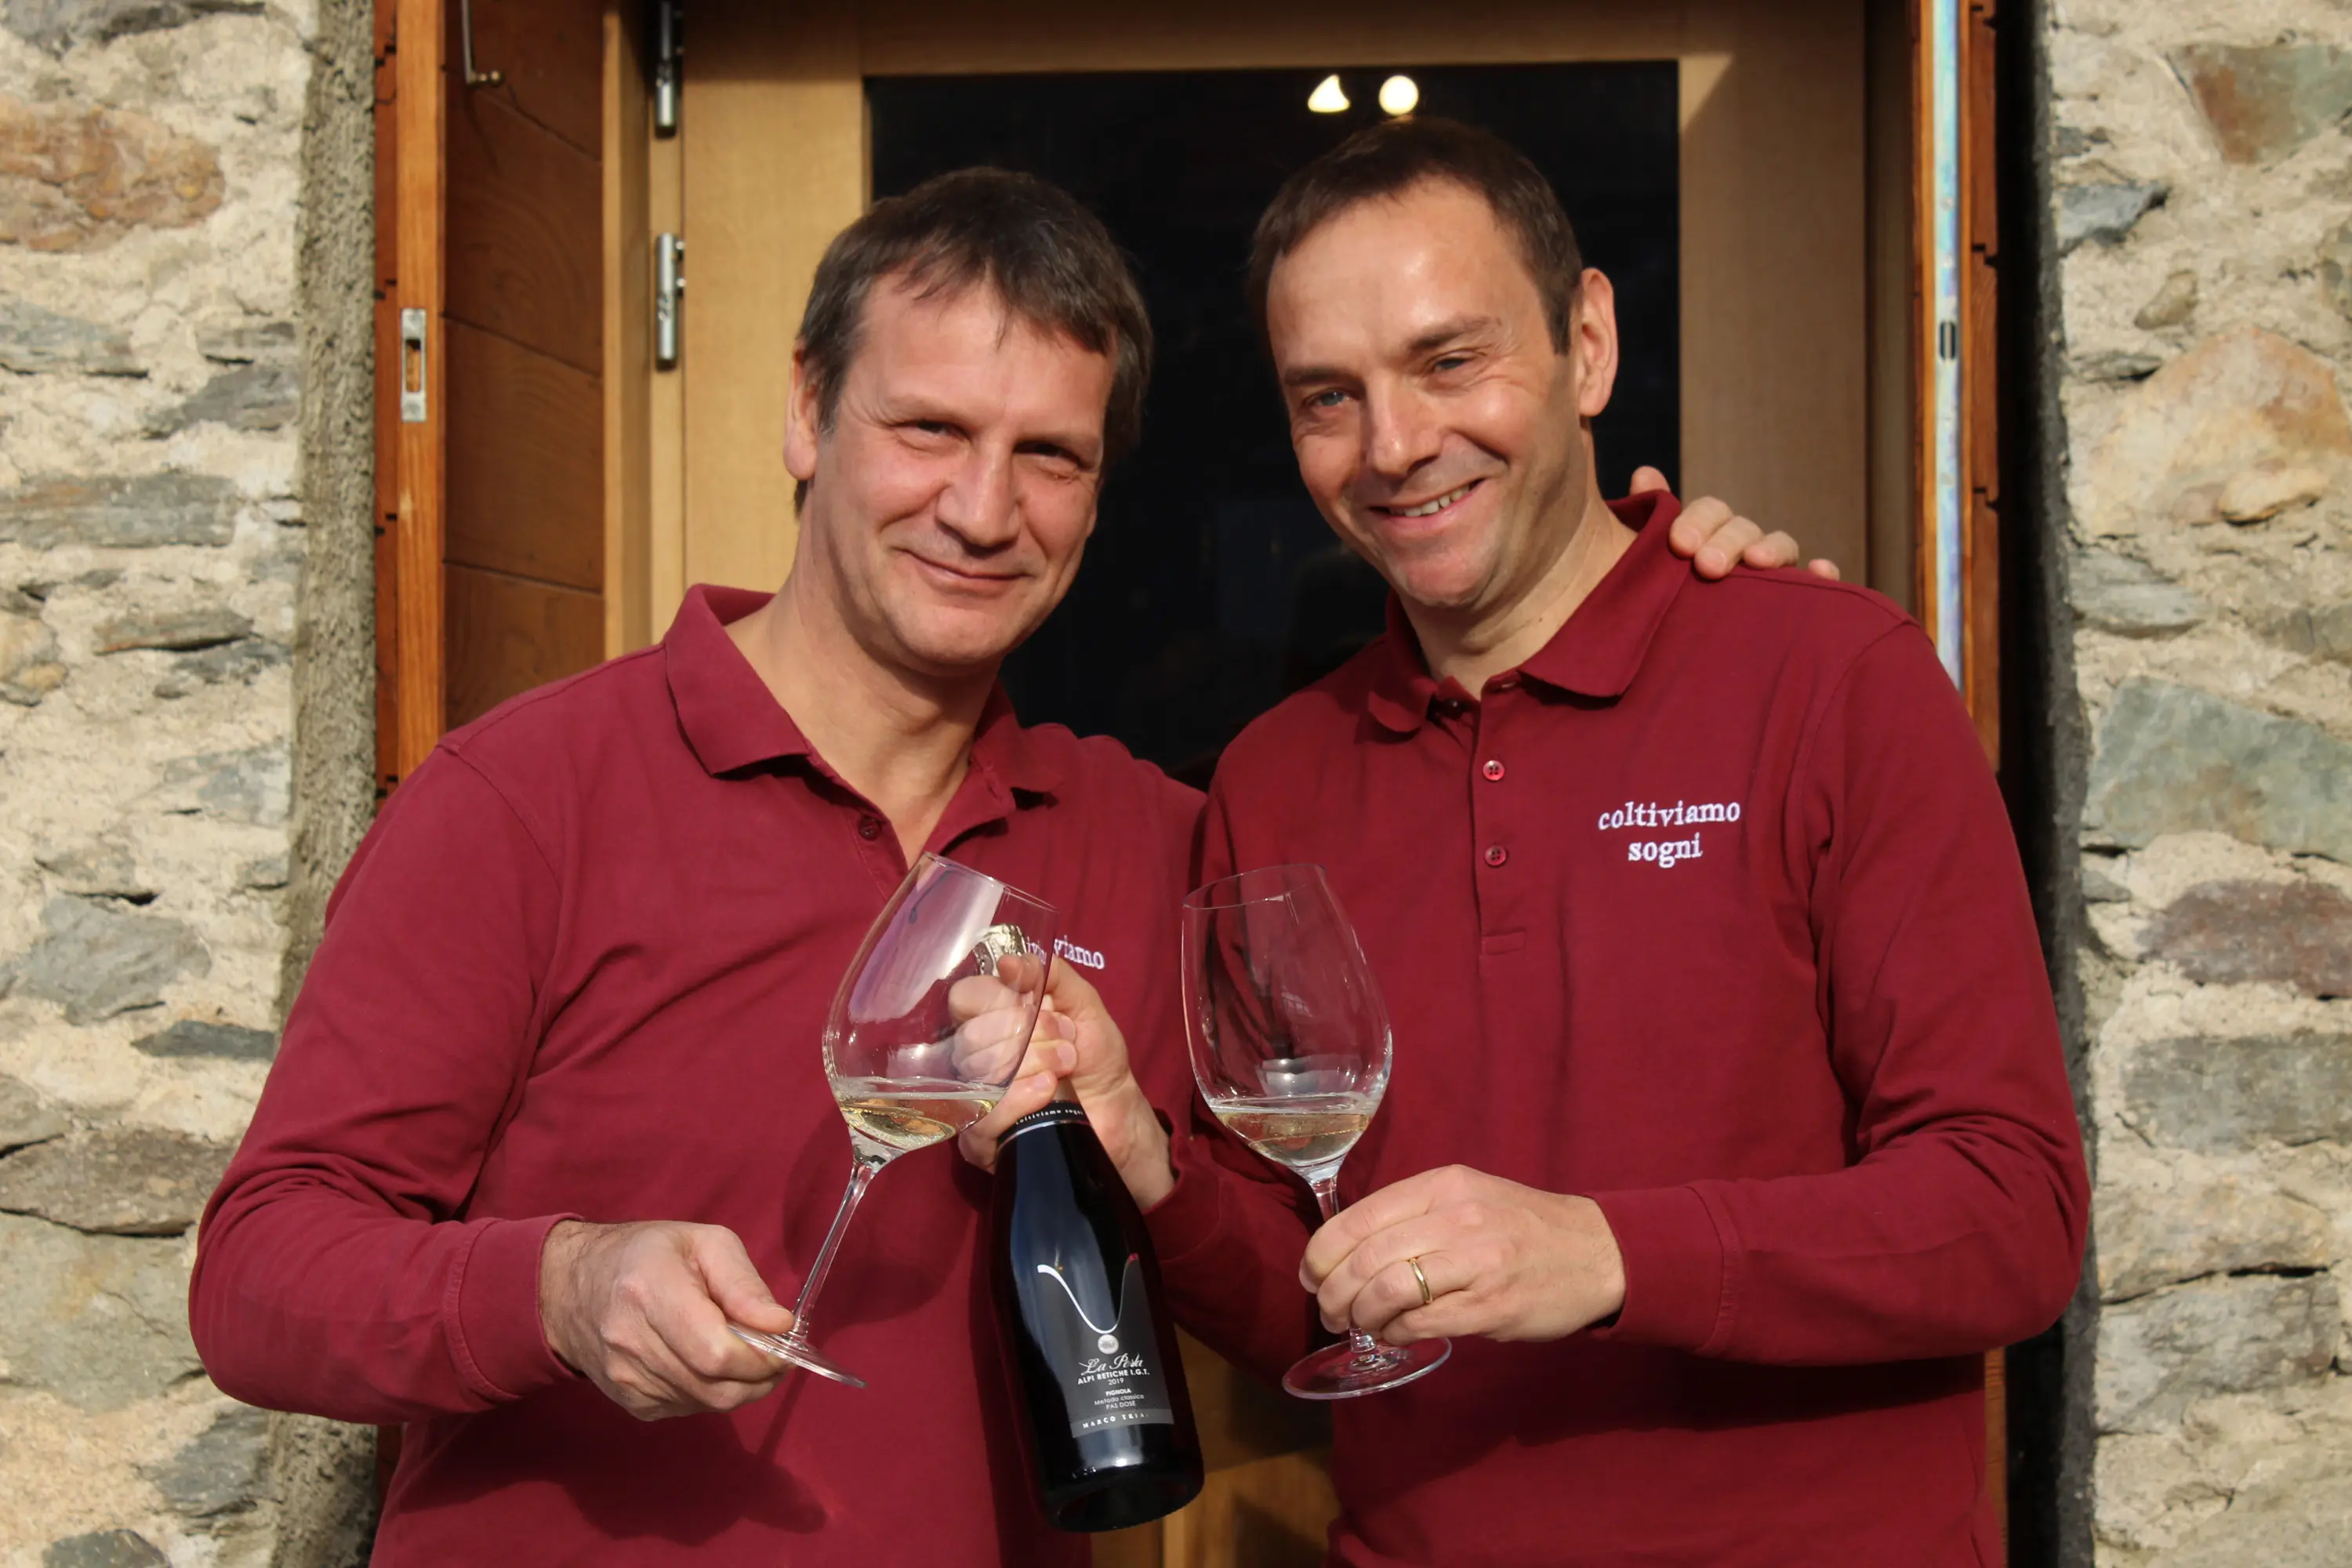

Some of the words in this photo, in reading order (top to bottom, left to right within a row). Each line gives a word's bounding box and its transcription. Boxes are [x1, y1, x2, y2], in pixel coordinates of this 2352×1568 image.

[1598, 800, 1741, 830] coltiviamo
[1628, 832, 1704, 869] sogni
[1077, 1375, 1095, 1385] ALPI
[1097, 1369, 1129, 1380] RETICHE
[1105, 1388, 1132, 1396] PIGNOLA
[1083, 1415, 1116, 1428] MARCO
